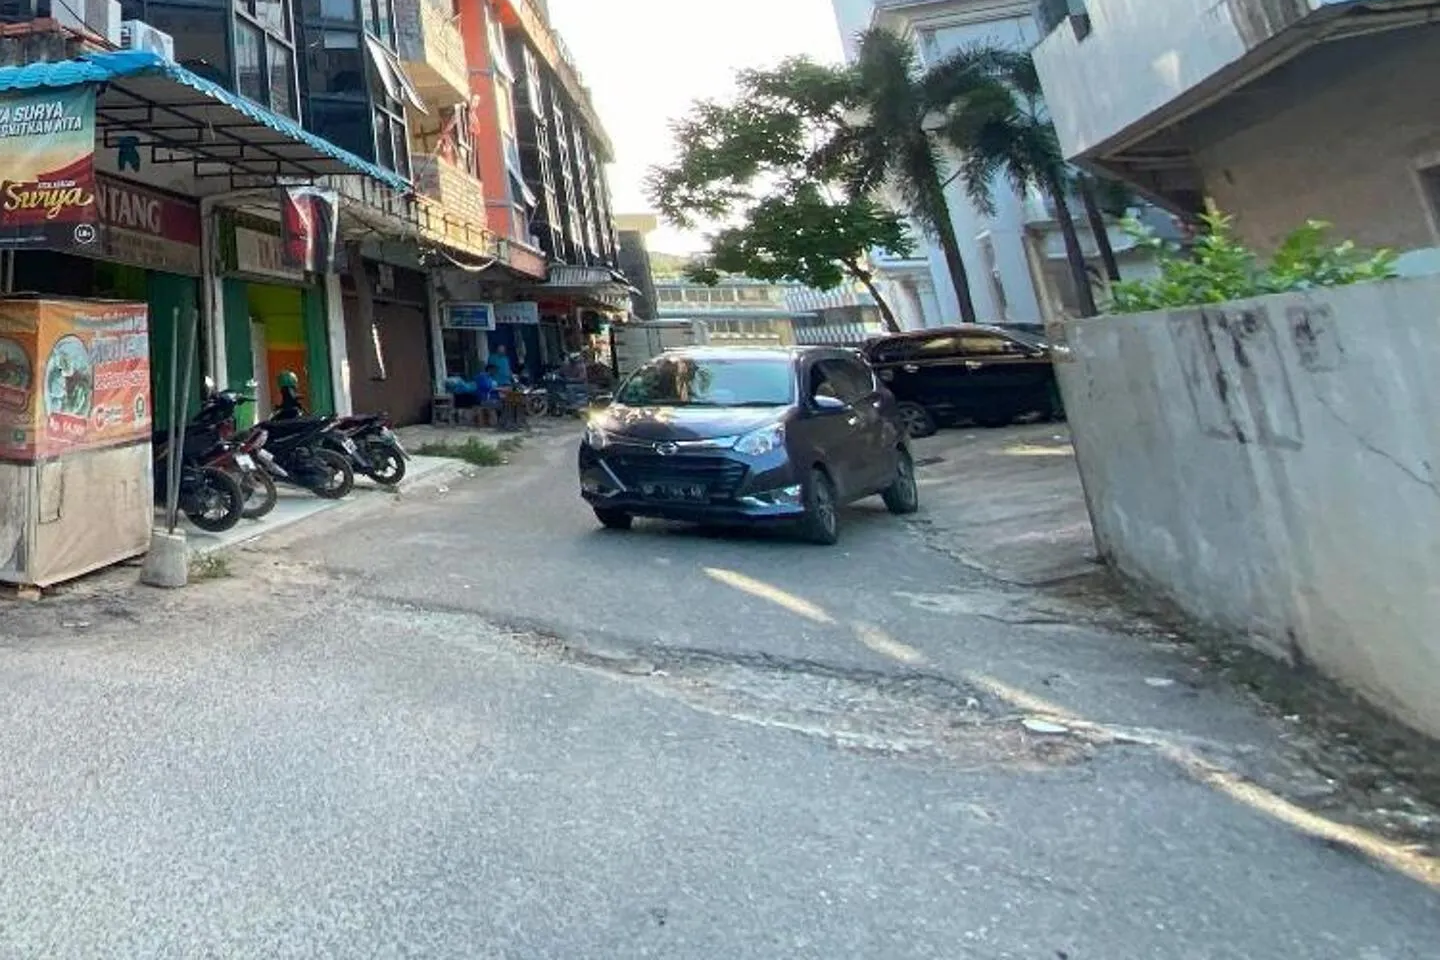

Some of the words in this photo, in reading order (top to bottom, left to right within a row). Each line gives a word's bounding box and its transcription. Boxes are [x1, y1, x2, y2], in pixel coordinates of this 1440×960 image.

[13, 101, 64, 122] SURYA
[3, 183, 95, 219] Surya
[95, 182, 161, 233] NTANG
